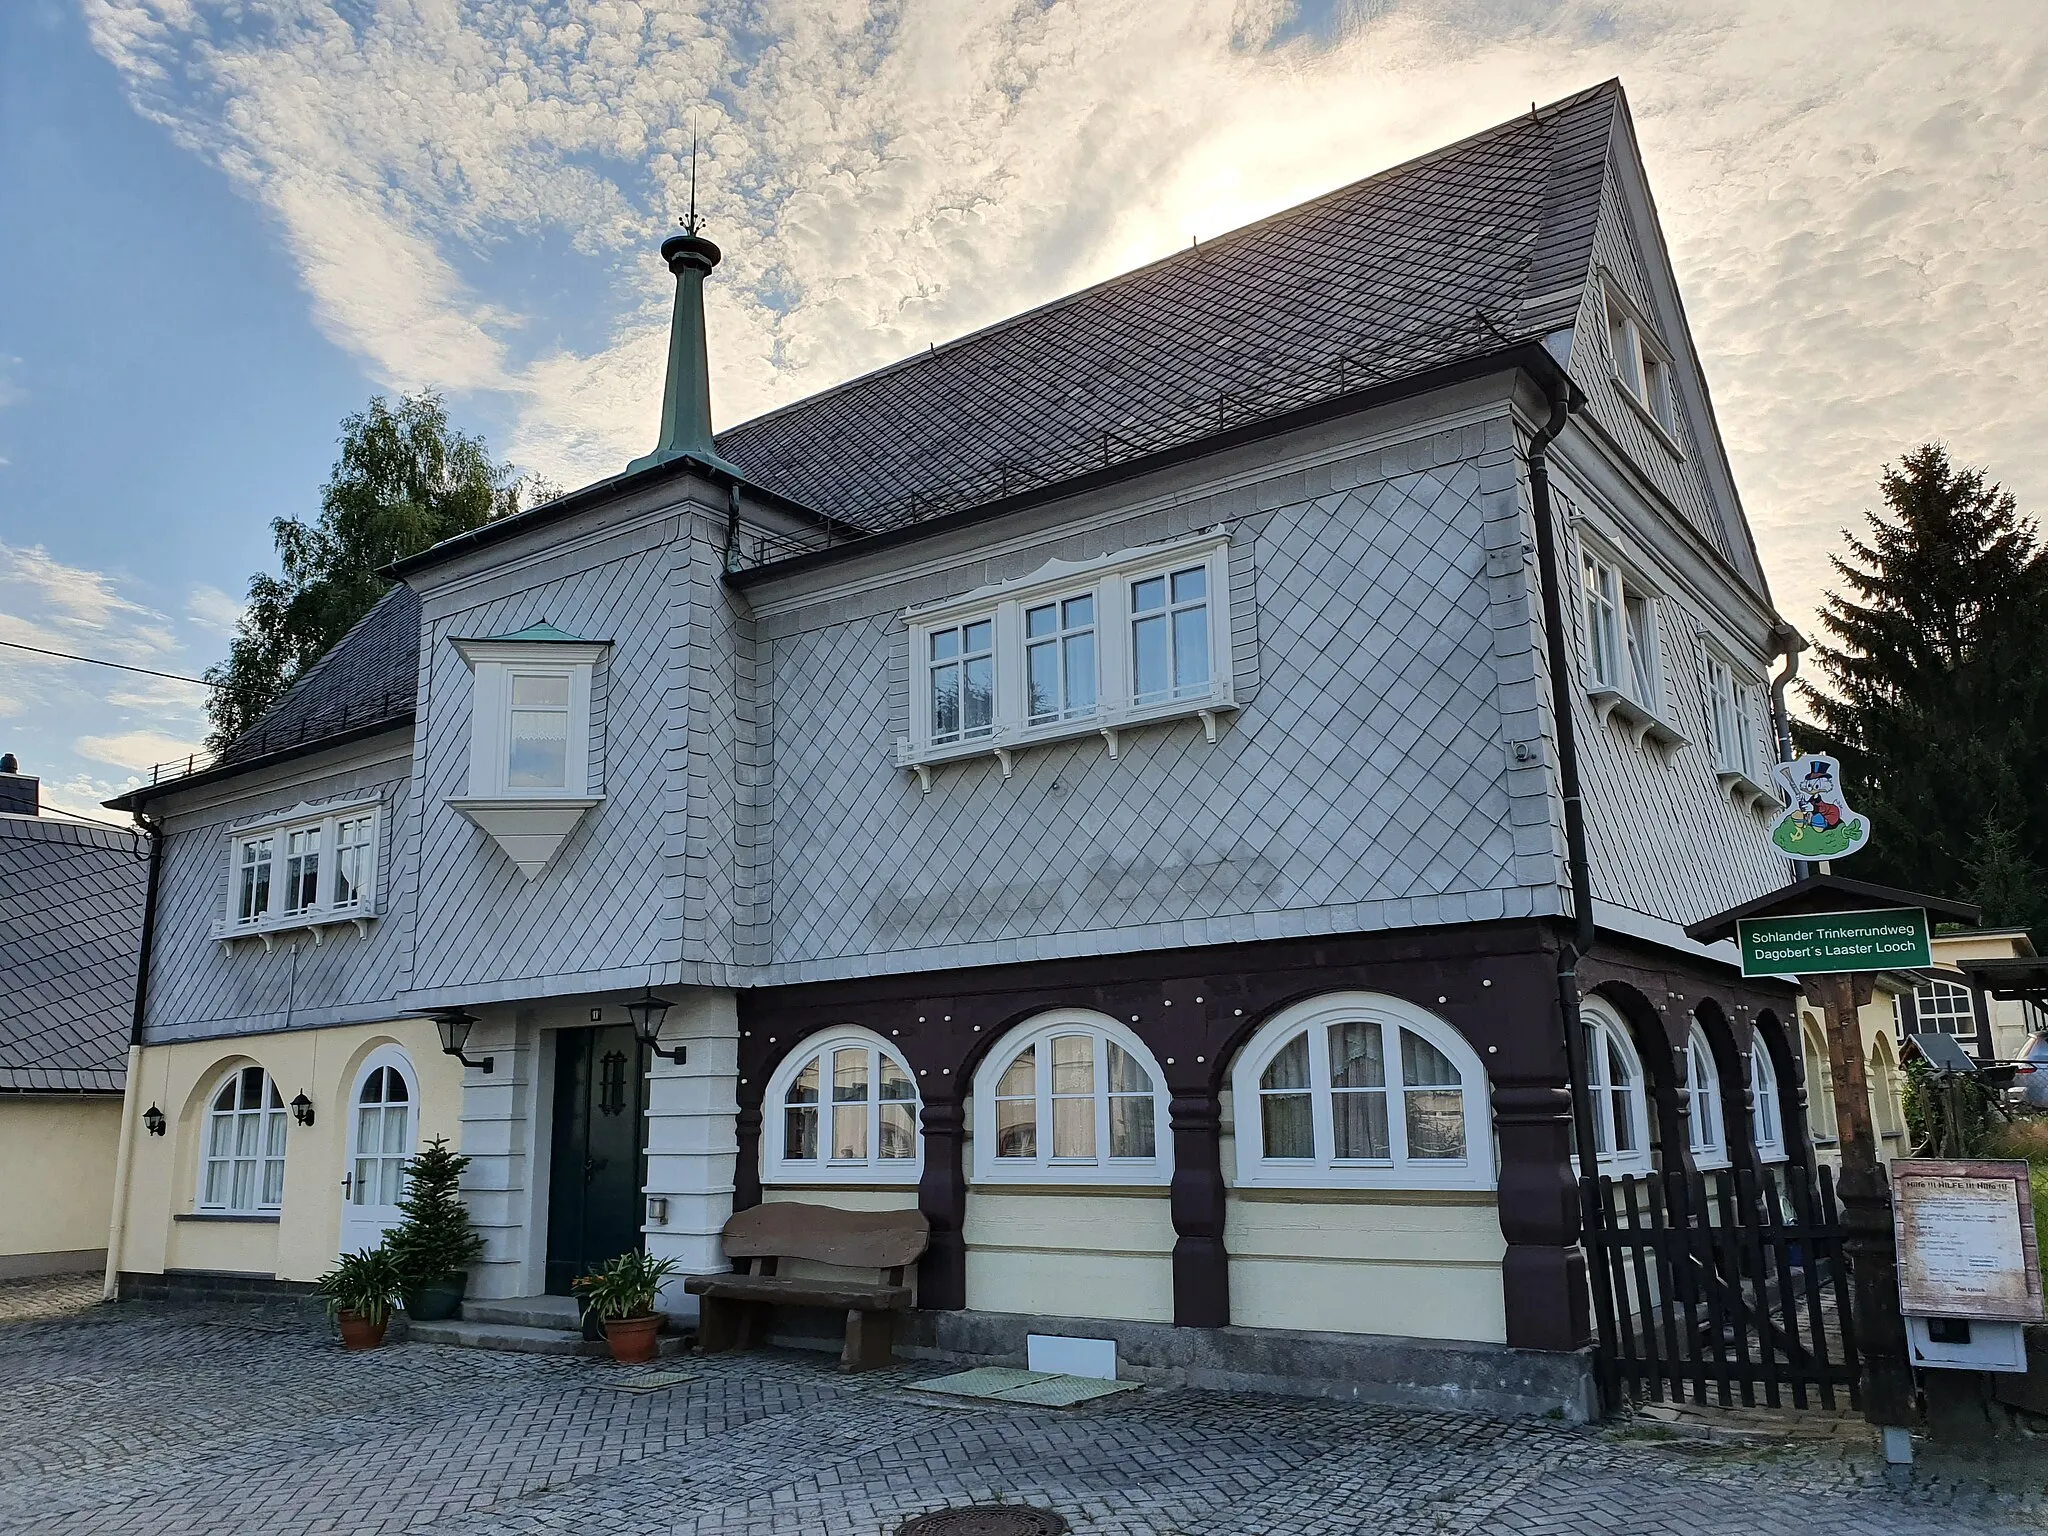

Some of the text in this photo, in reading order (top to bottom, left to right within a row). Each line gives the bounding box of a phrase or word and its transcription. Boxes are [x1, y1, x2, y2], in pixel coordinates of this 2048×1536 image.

[1752, 925, 1914, 943] Sohlander Trinkerrundweg
[1825, 944, 1872, 956] Laaster
[1876, 941, 1915, 953] Looch
[1938, 1181, 1964, 1189] HILFE
[1977, 1181, 1997, 1190] Hilfe
